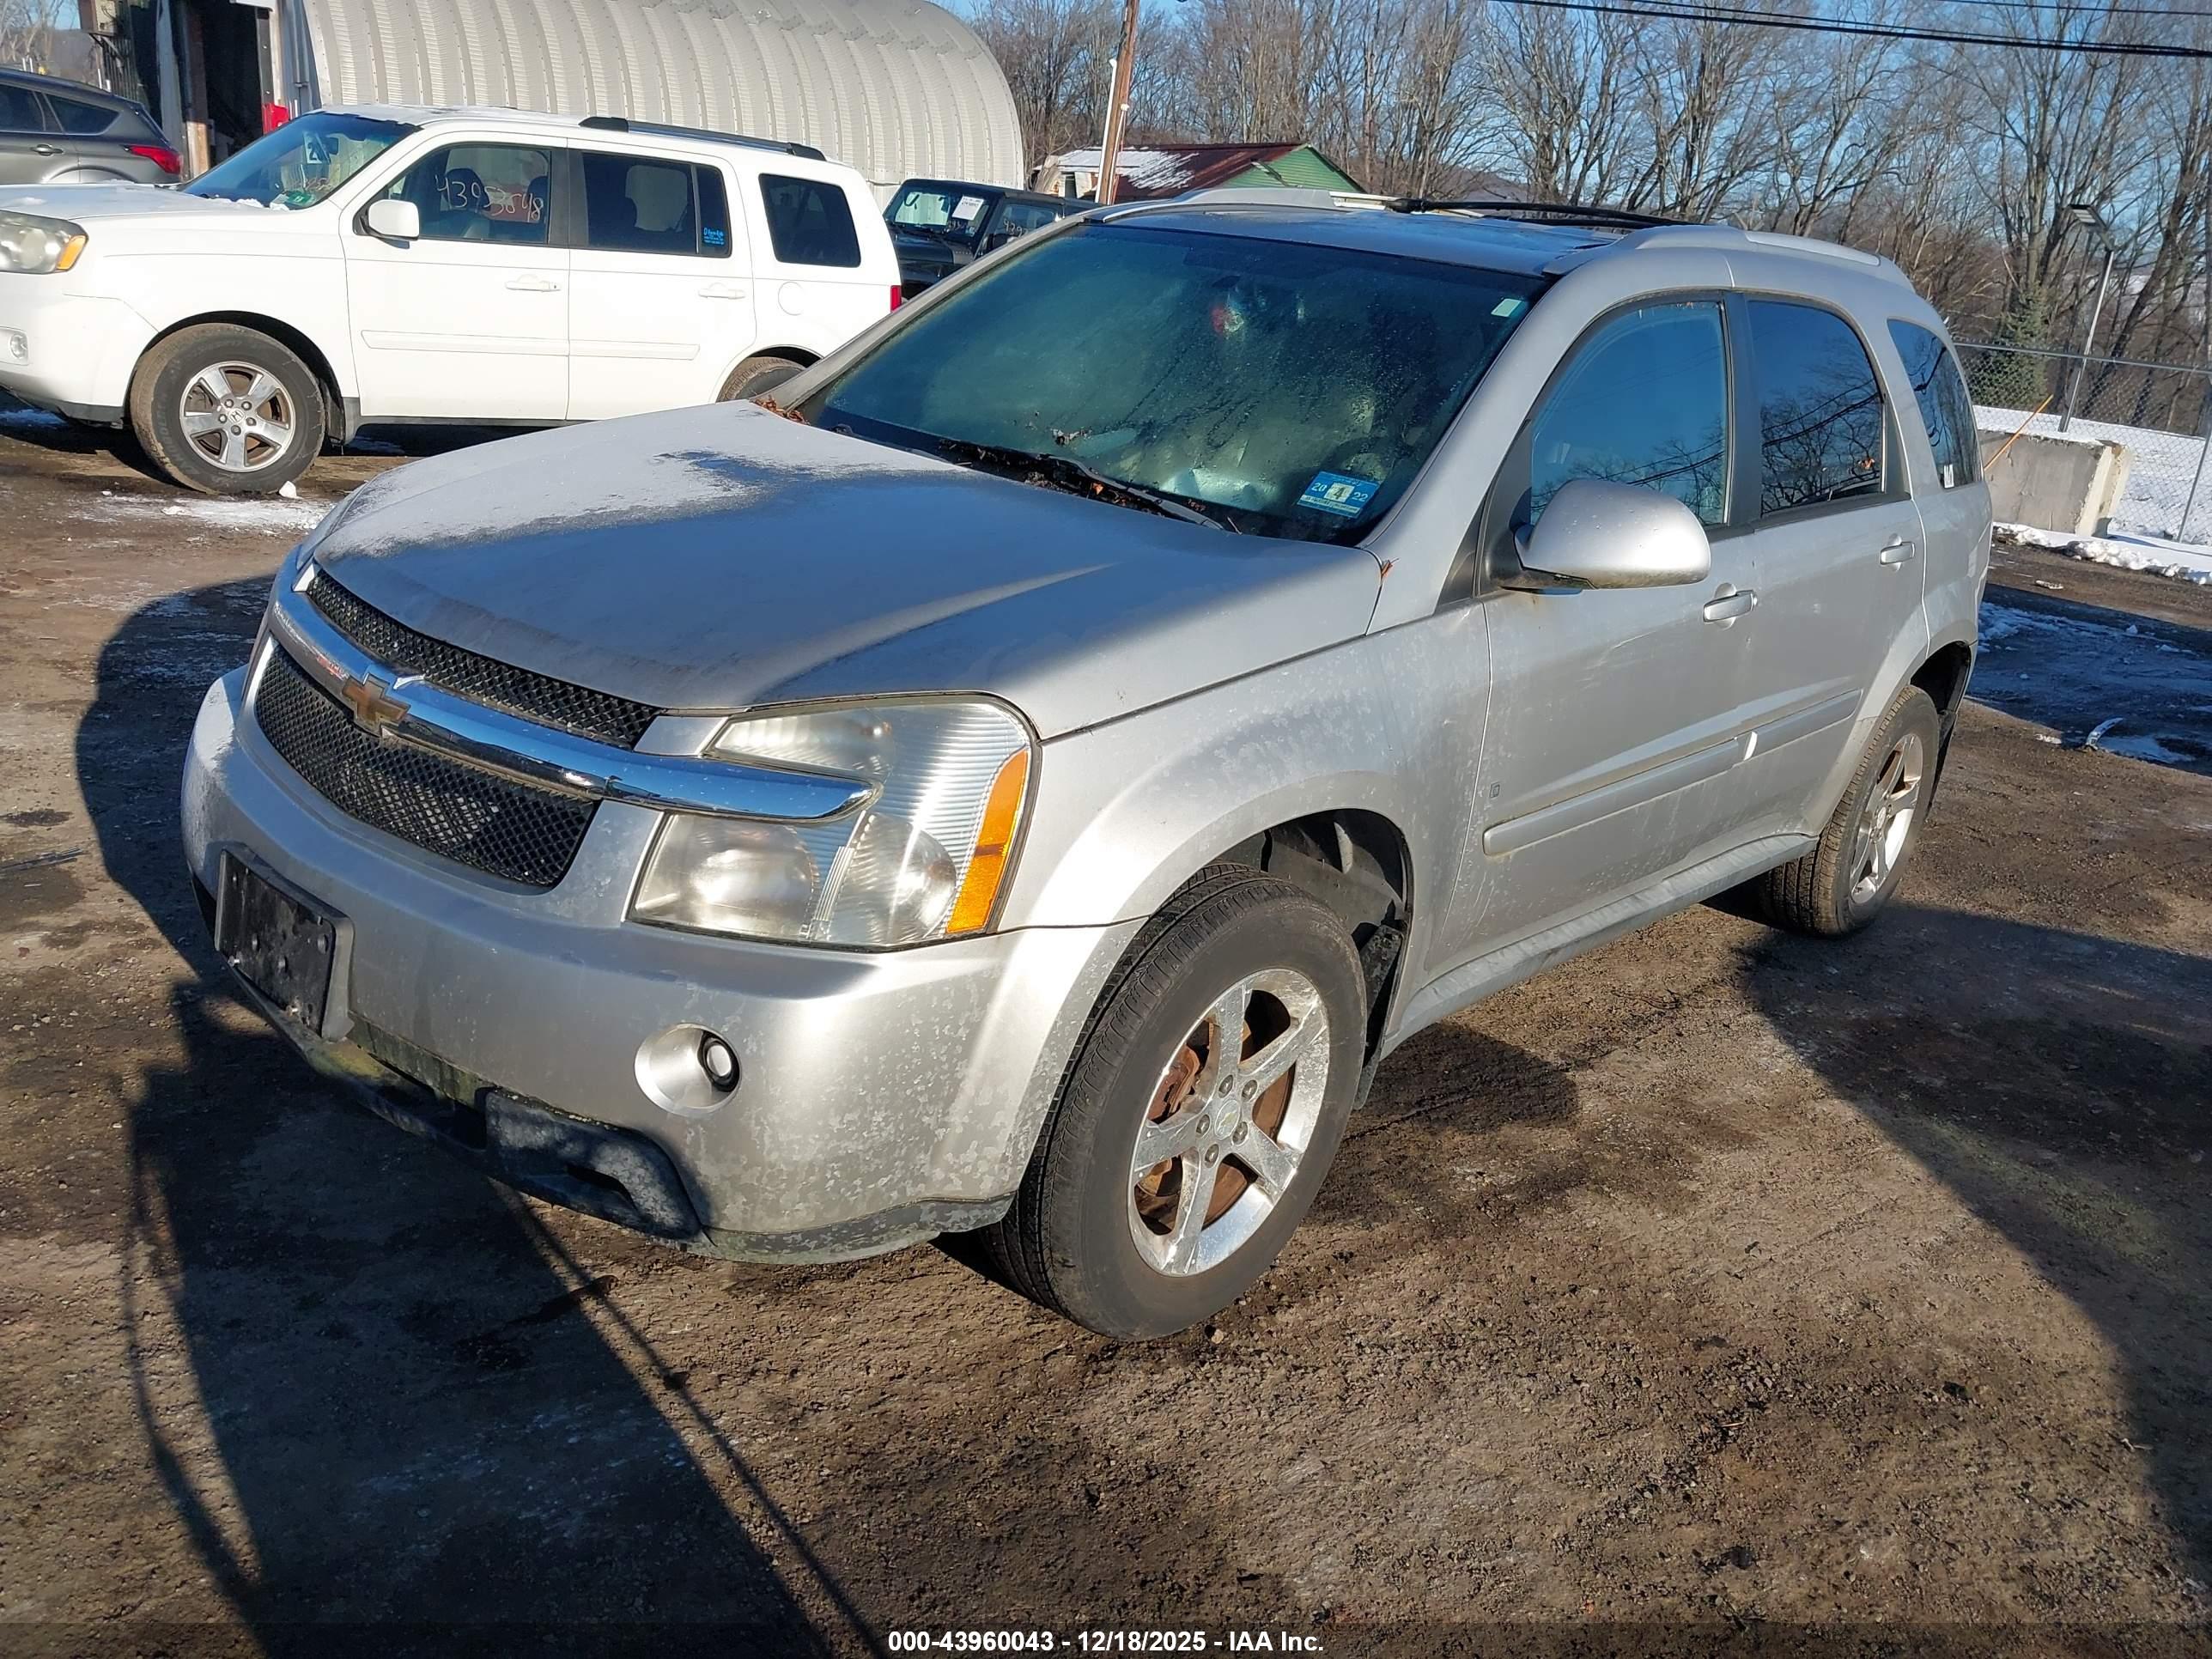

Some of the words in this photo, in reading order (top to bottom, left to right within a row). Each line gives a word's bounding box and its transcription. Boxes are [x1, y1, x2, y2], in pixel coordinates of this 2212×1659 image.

[1311, 482, 1328, 492] 20
[1334, 487, 1346, 500] 4
[1352, 491, 1369, 502] 22
